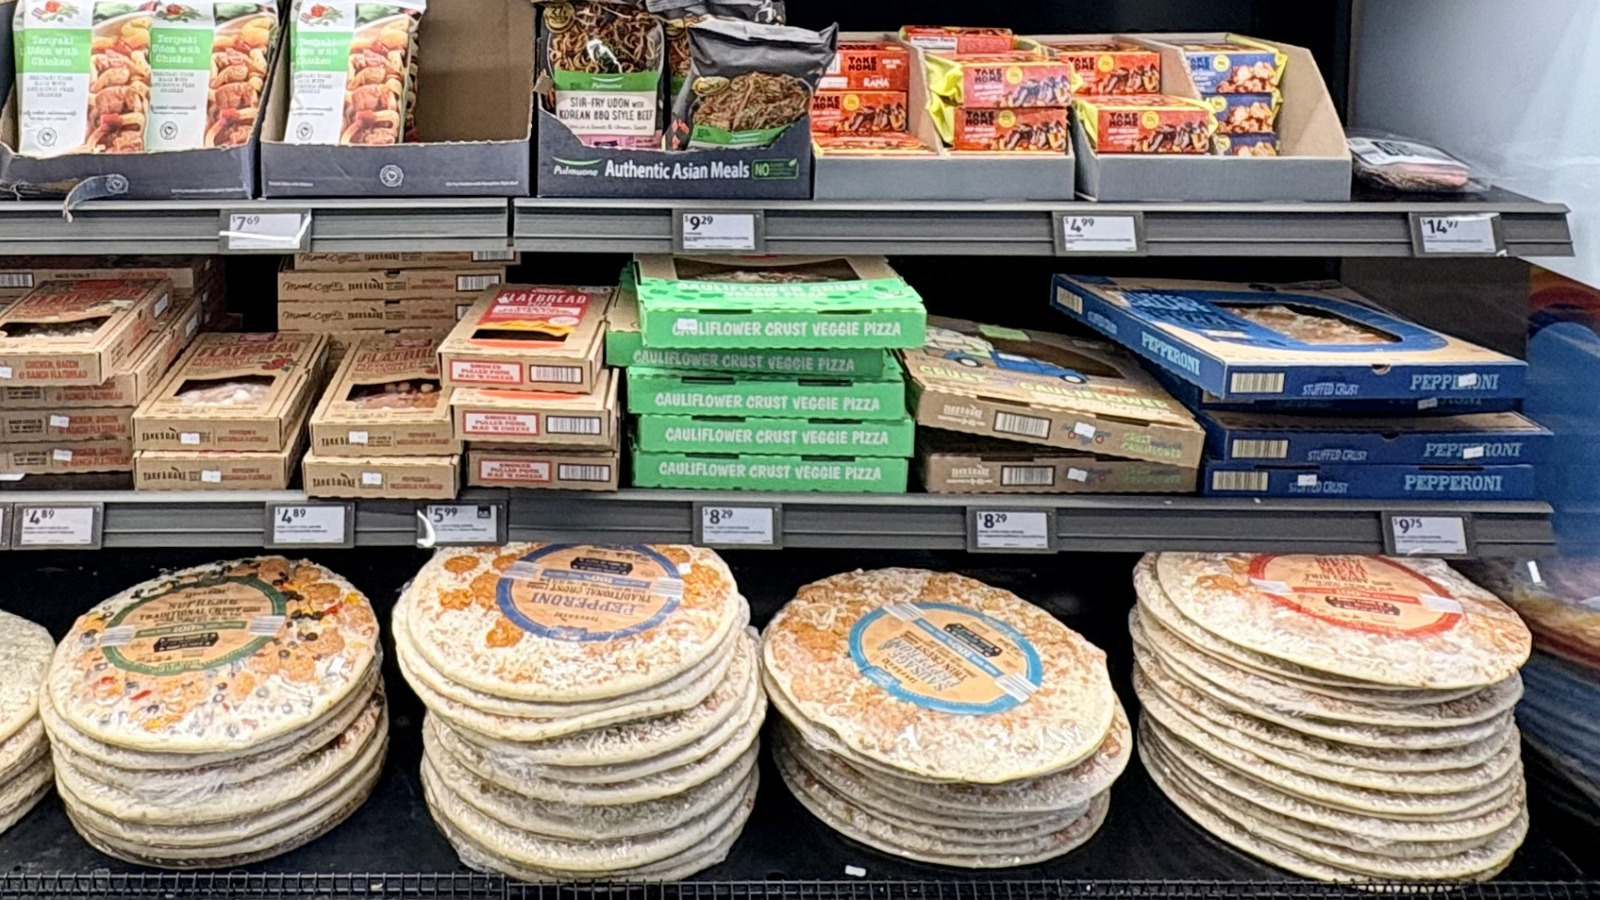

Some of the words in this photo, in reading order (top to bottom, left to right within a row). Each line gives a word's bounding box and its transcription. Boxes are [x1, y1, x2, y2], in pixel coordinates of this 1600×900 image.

[32, 35, 74, 46] Teriyaki
[157, 34, 198, 45] Teriyaki
[179, 44, 201, 54] with
[31, 57, 72, 66] Chicken
[155, 54, 194, 64] Chicken
[848, 56, 877, 64] TAKE
[1074, 63, 1095, 71] OME
[570, 97, 606, 108] STIR-FRY
[607, 98, 630, 108] UDON
[813, 95, 840, 103] TAKE
[559, 109, 591, 120] KOREAN
[594, 109, 610, 121] BBQ
[612, 109, 635, 121] STYLE
[637, 109, 654, 121] BEEF
[966, 110, 995, 118] TAKE
[1109, 112, 1138, 120] TAKE
[965, 118, 994, 126] HOME
[554, 165, 599, 177] Pulmuone
[604, 159, 670, 179] Authentic
[672, 162, 708, 179] Asian
[710, 160, 750, 179] Meals
[754, 163, 770, 176] NO
[764, 323, 807, 337] CRUST
[812, 322, 859, 336] VEGGIE
[863, 322, 901, 336] PIZZA
[1141, 331, 1200, 375] PEPPERONI
[633, 350, 719, 368] CAULIFLOWER
[721, 354, 763, 370] CRUST
[767, 356, 813, 371] VEGGIE
[817, 357, 855, 371] PIZZA
[919, 365, 986, 383] CRUST
[1019, 381, 1171, 409] CAULIFLOWER
[1302, 382, 1334, 396] STUFFED
[1335, 383, 1360, 395] CRUST
[655, 392, 742, 408] CAULIFLOWER
[746, 395, 788, 410] CRUST
[793, 395, 838, 411] VEGGIE
[843, 396, 880, 411] PIZZA
[665, 428, 752, 444] CAULIFLOWER
[756, 429, 797, 445] CRUST
[802, 430, 847, 445] VEGGIE
[852, 430, 889, 445] PIZZA
[1308, 449, 1341, 461] STUFFED
[1342, 449, 1368, 461] CRUST
[659, 461, 746, 478] CAULIFLOWER
[749, 464, 791, 479] CRUST
[795, 465, 841, 480] VEGGIE
[845, 466, 881, 481] PIZZA
[1323, 481, 1349, 493] CRUST
[1403, 475, 1503, 491] PEPPERONI
[531, 592, 637, 616] PEPPERONI
[140, 607, 205, 621] TRADITIONAL
